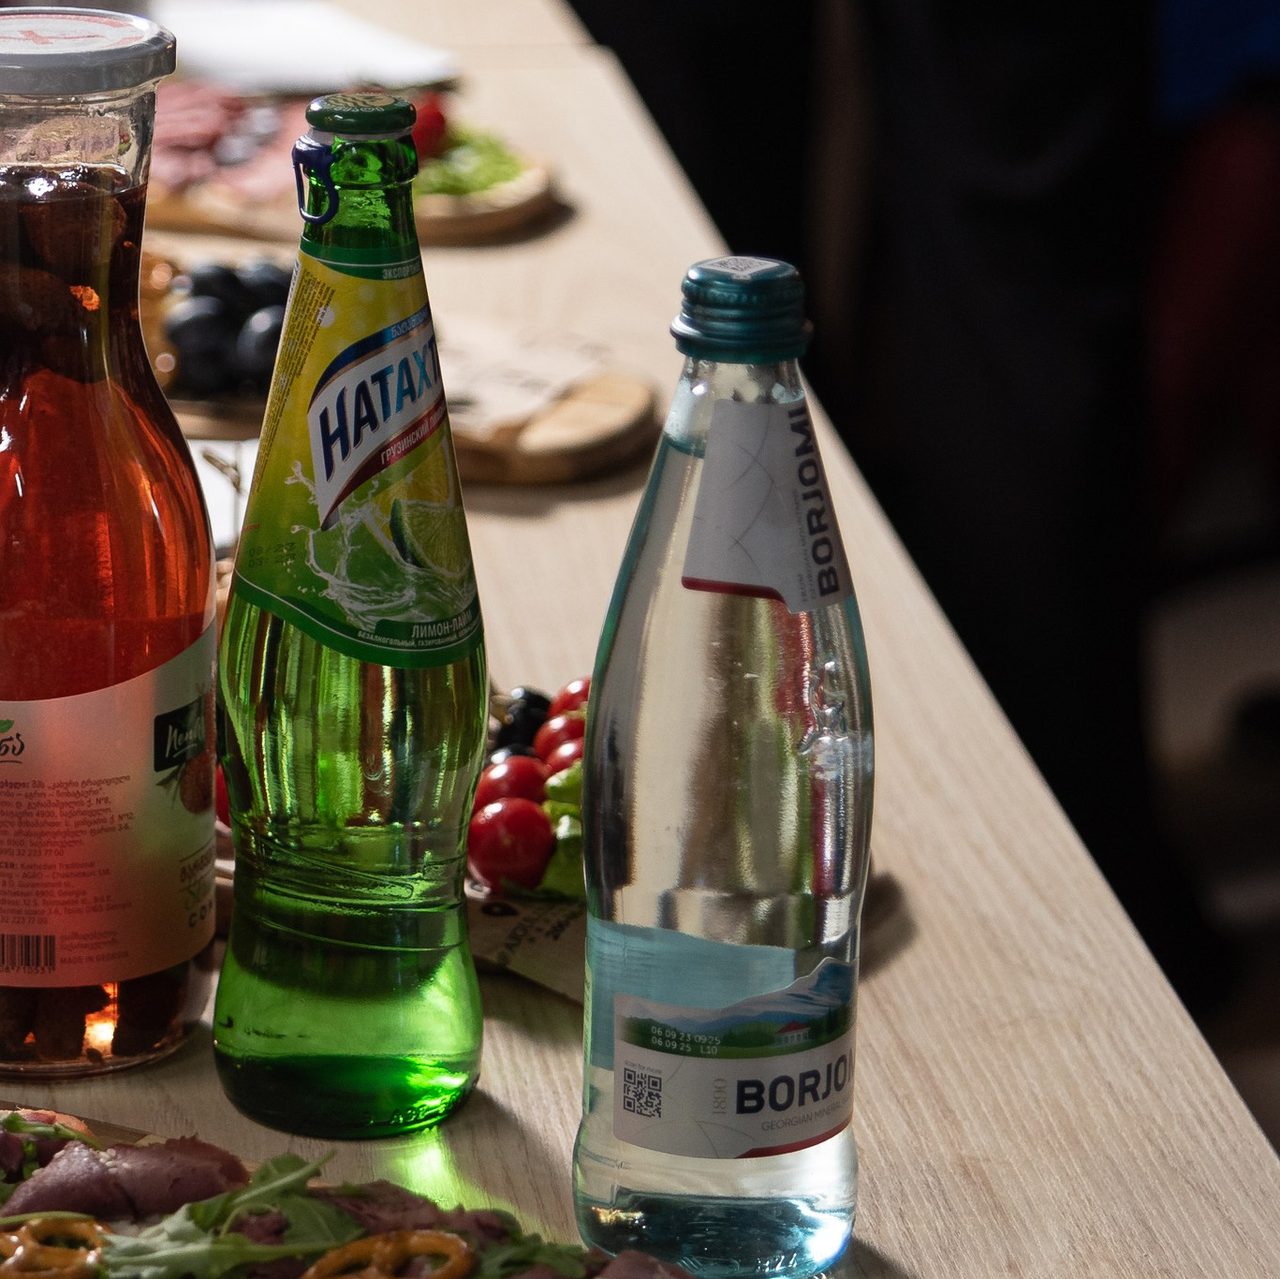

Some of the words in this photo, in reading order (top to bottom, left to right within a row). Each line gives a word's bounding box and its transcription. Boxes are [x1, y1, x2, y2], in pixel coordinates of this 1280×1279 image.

[319, 335, 440, 482] НАТАХТ
[380, 421, 429, 466] ГРУЗИНСКИЙ
[787, 405, 841, 598] BORJOMI
[411, 609, 473, 639] ЛИМОН-ЛАЙМ
[651, 1025, 663, 1036] 06
[665, 1029, 677, 1040] 09
[651, 1036, 663, 1047] 06
[665, 1039, 677, 1050] 09
[679, 1043, 692, 1053] 25
[646, 1066, 663, 1075] more
[712, 1078, 728, 1115] 1890
[761, 1111, 813, 1132] GEORGIAN
